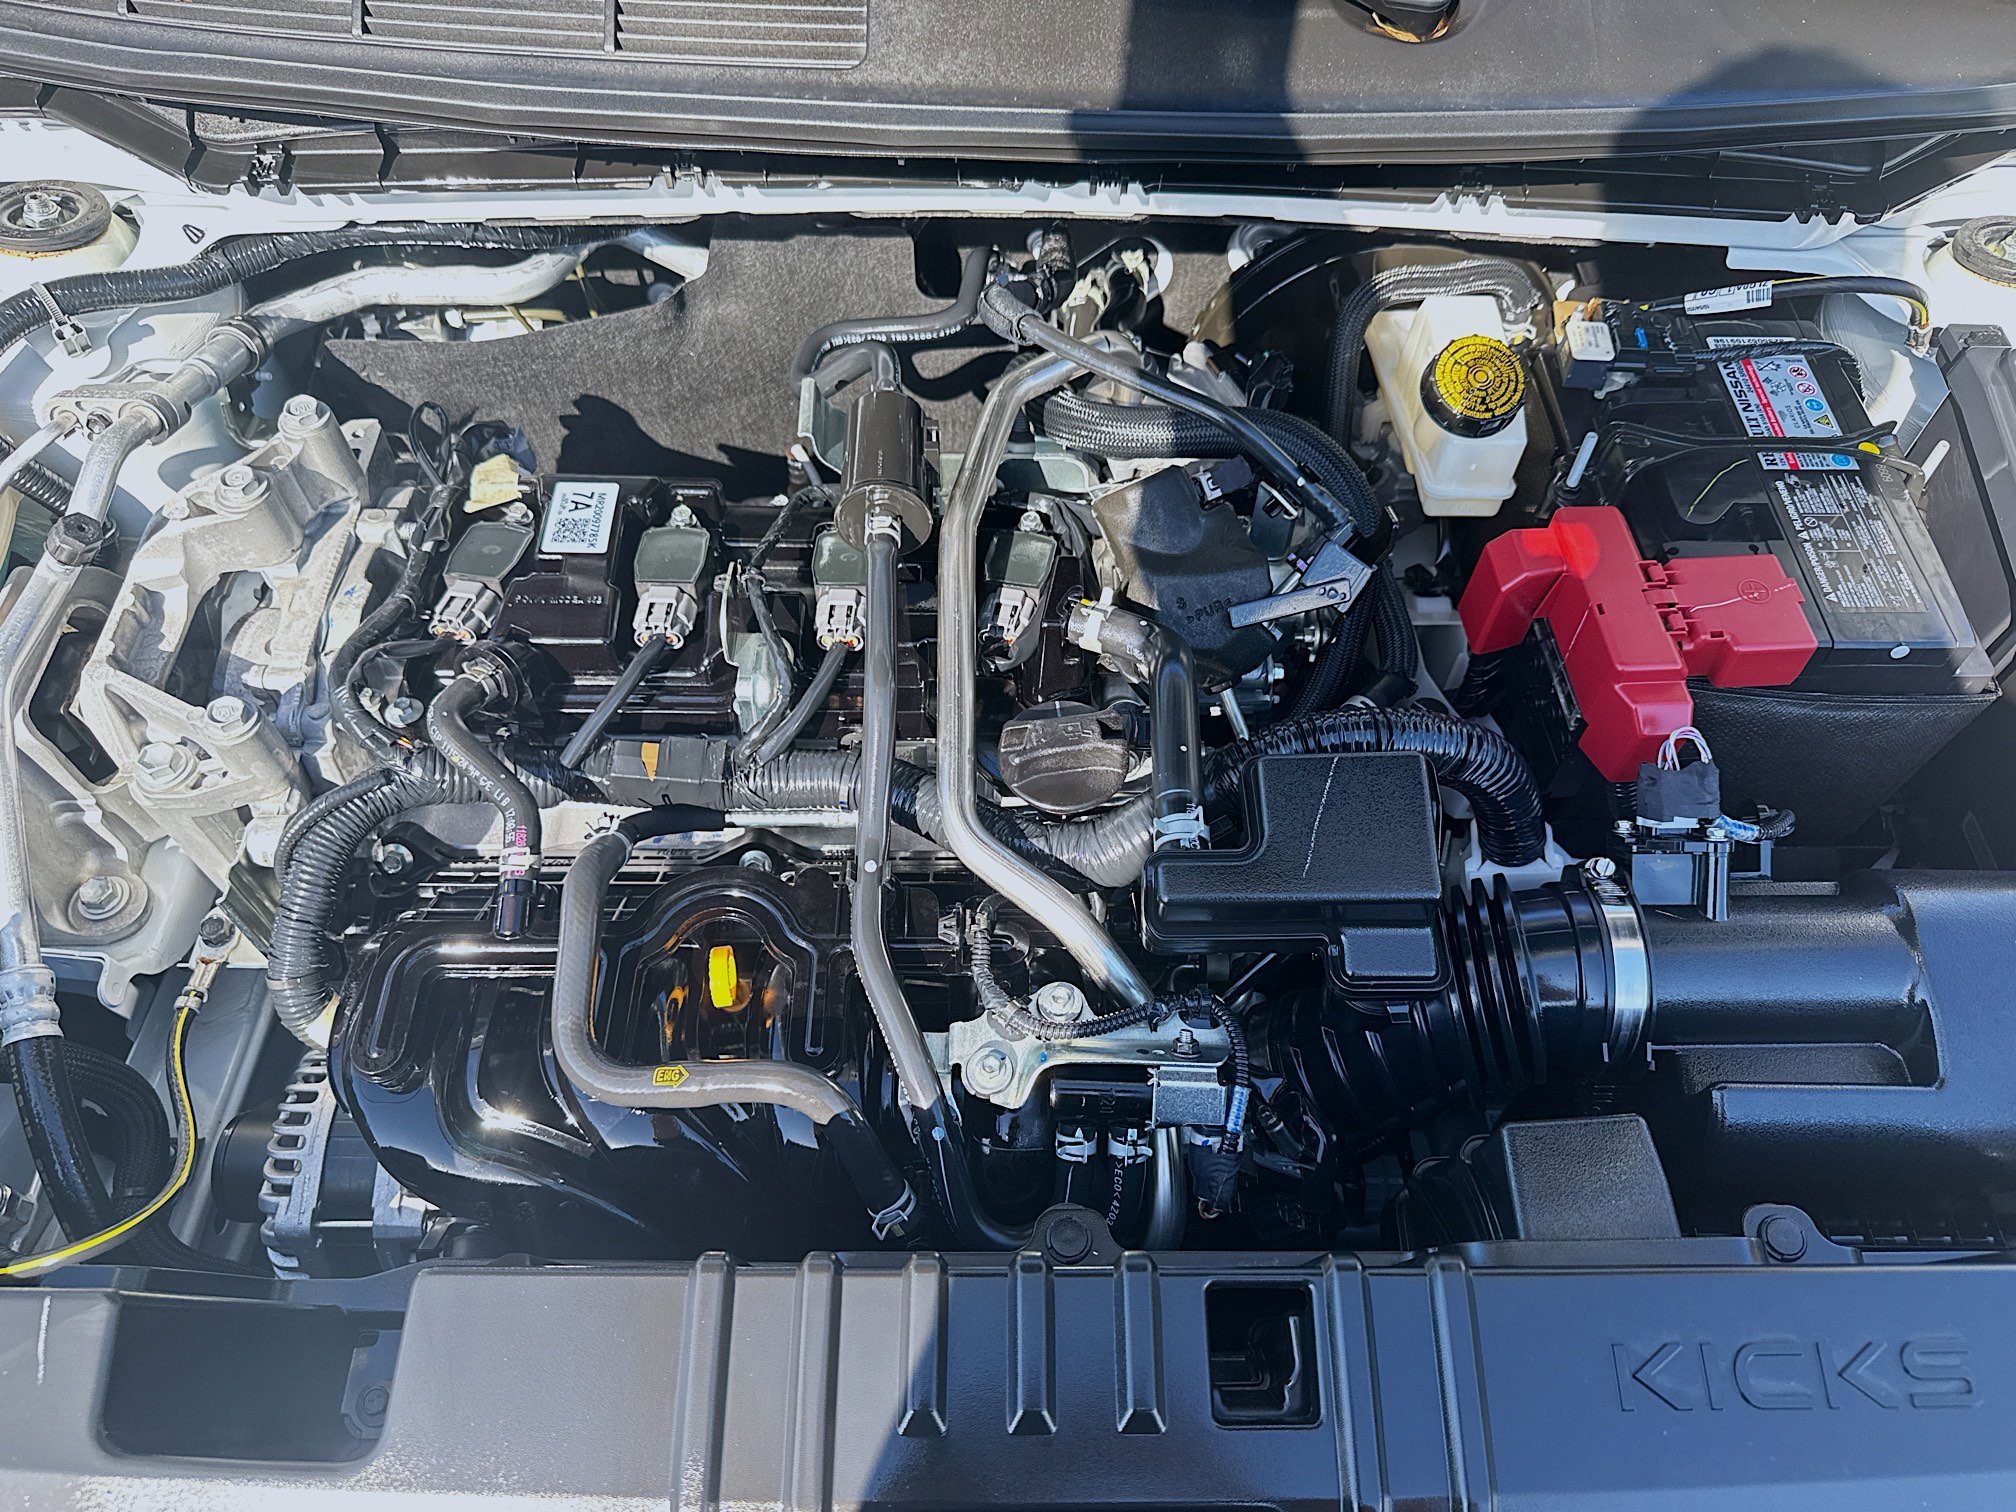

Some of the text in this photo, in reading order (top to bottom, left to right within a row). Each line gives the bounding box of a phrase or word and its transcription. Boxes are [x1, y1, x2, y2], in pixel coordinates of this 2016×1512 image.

[1722, 361, 1755, 412] NISSAN
[1785, 405, 1801, 428] CLARIOS
[568, 491, 595, 512] 7A
[1802, 542, 1833, 593] DANGER/POISON
[656, 1069, 680, 1082] ENG
[1611, 1336, 1984, 1411] KICKS
